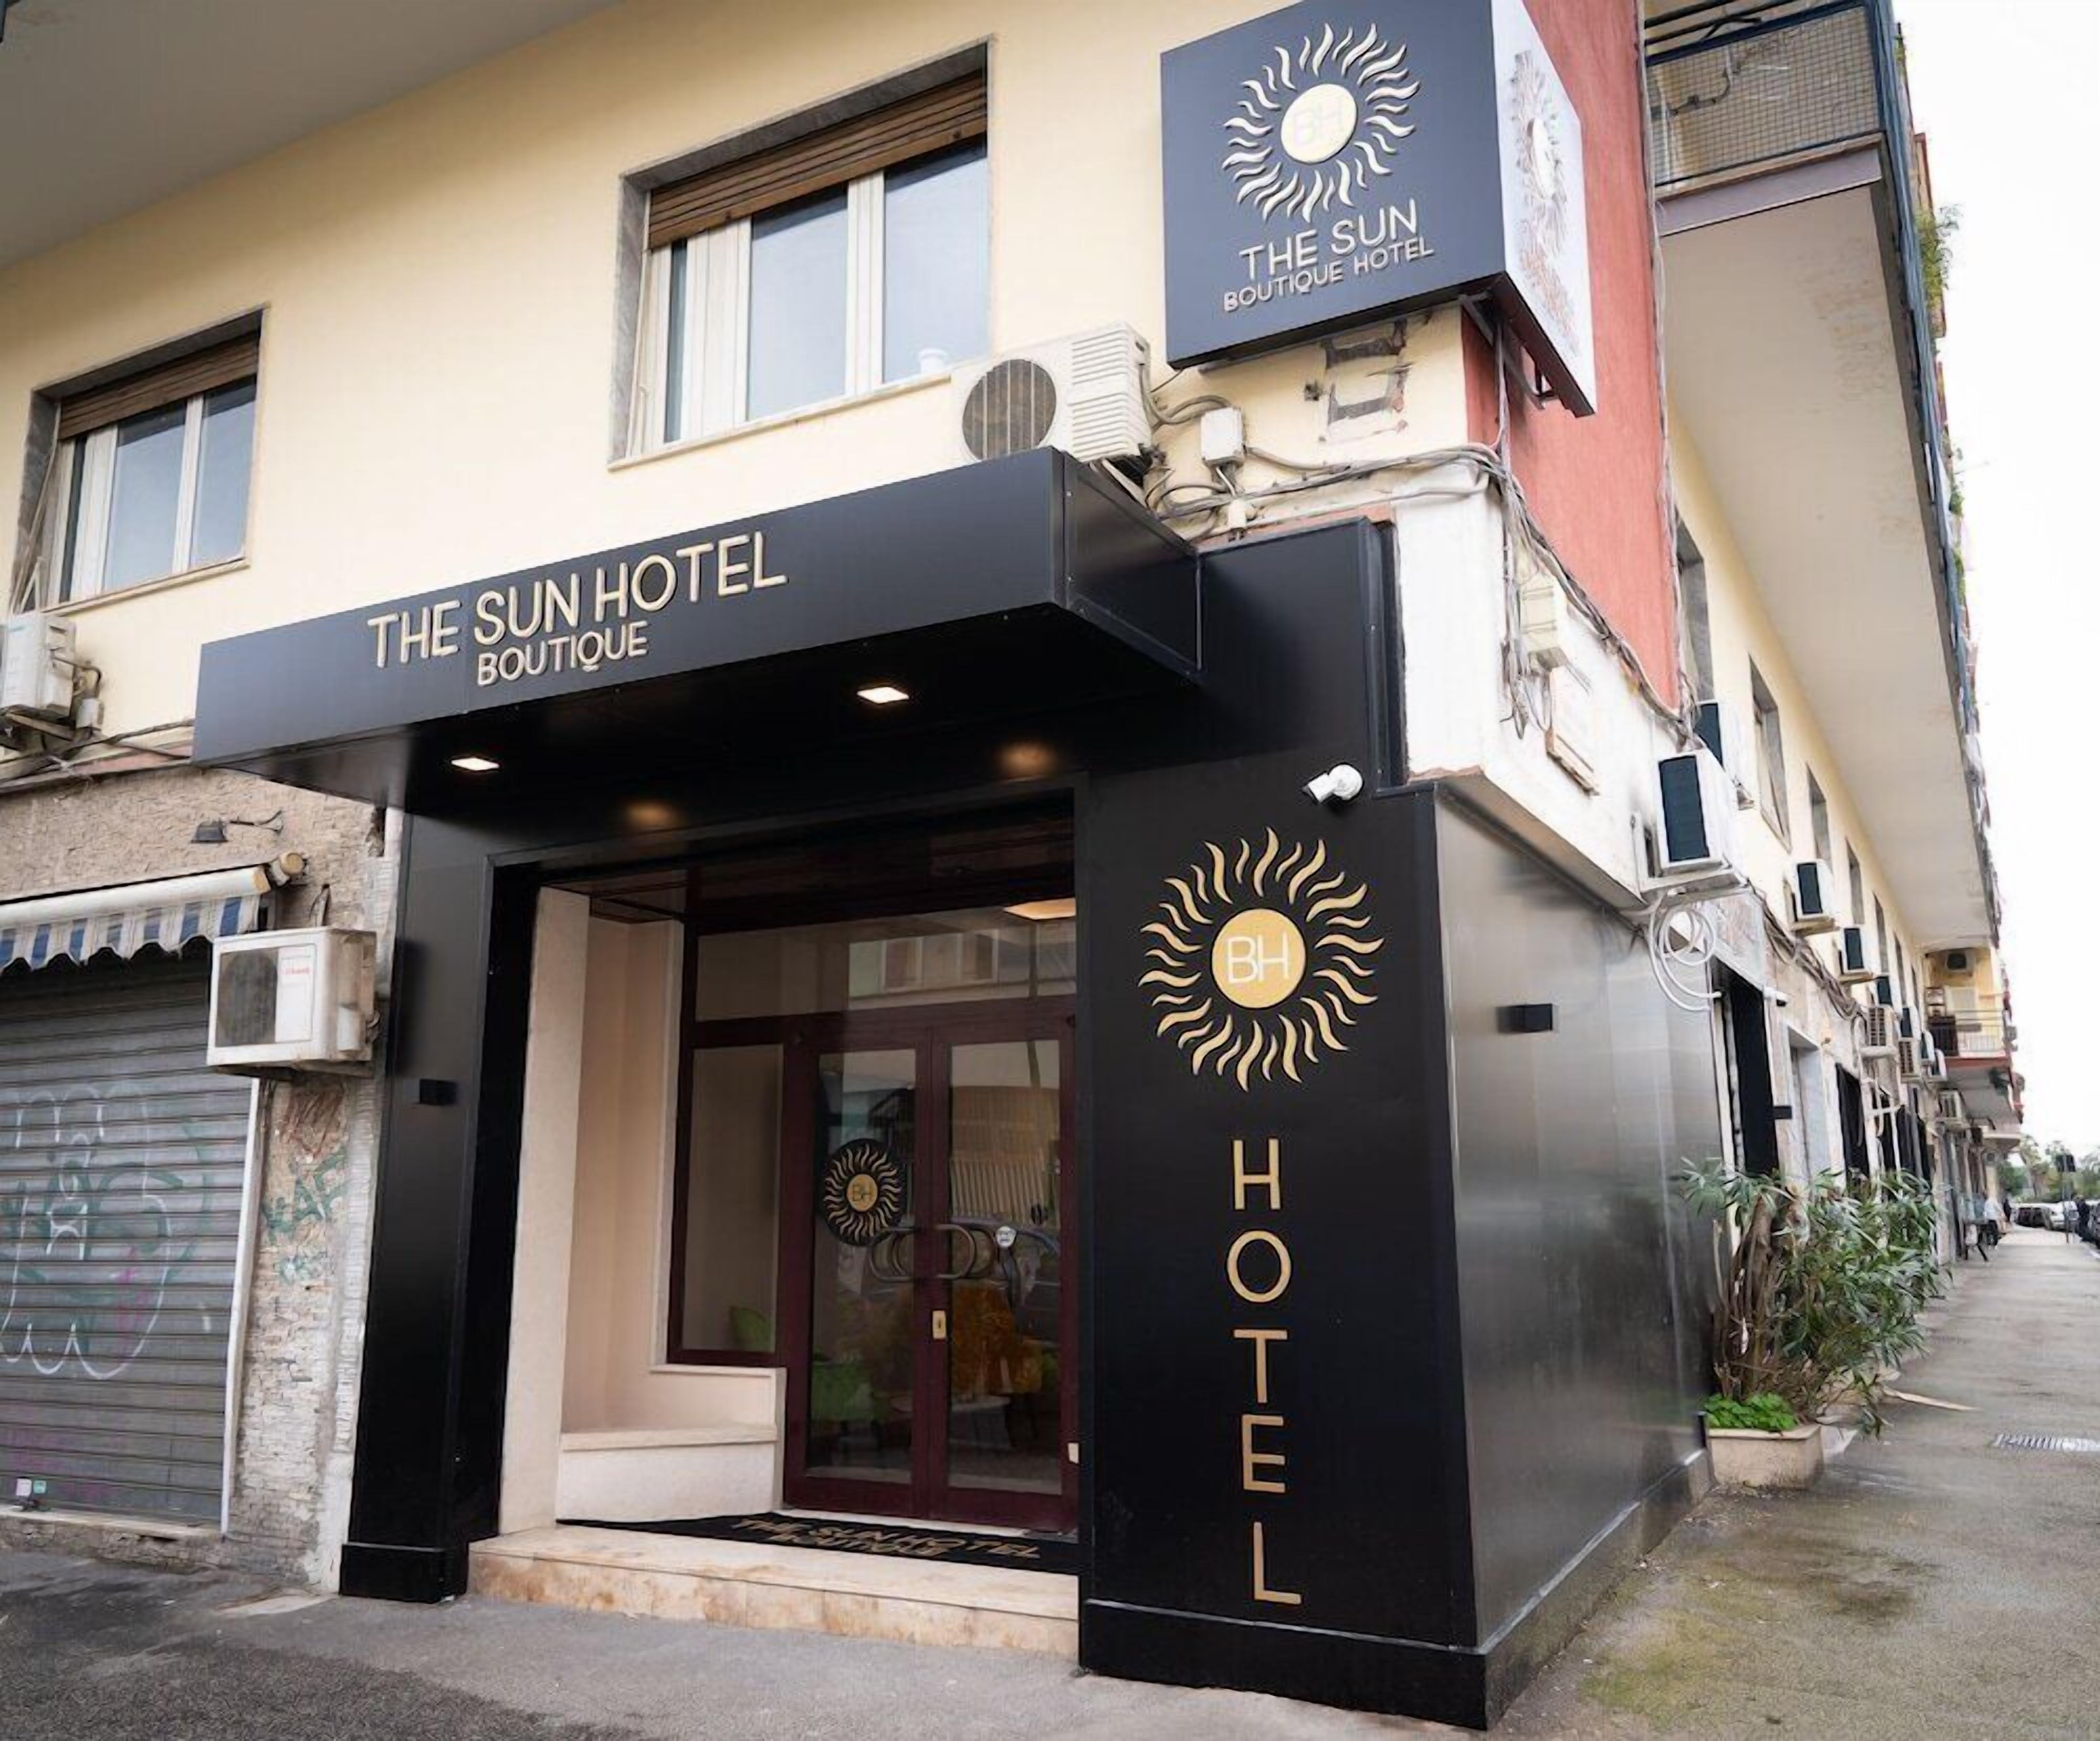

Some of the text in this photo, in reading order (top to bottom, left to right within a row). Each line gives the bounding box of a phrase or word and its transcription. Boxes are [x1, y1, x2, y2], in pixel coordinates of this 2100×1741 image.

[1223, 237, 1434, 312] BOUTIQUE HOTEL
[1238, 198, 1419, 280] THE SUN
[367, 530, 788, 668] THE SUN HOTEL
[477, 620, 649, 687] BOUTIQUE
[1226, 933, 1290, 984] BH
[1226, 1138, 1303, 1604] HOTEL
